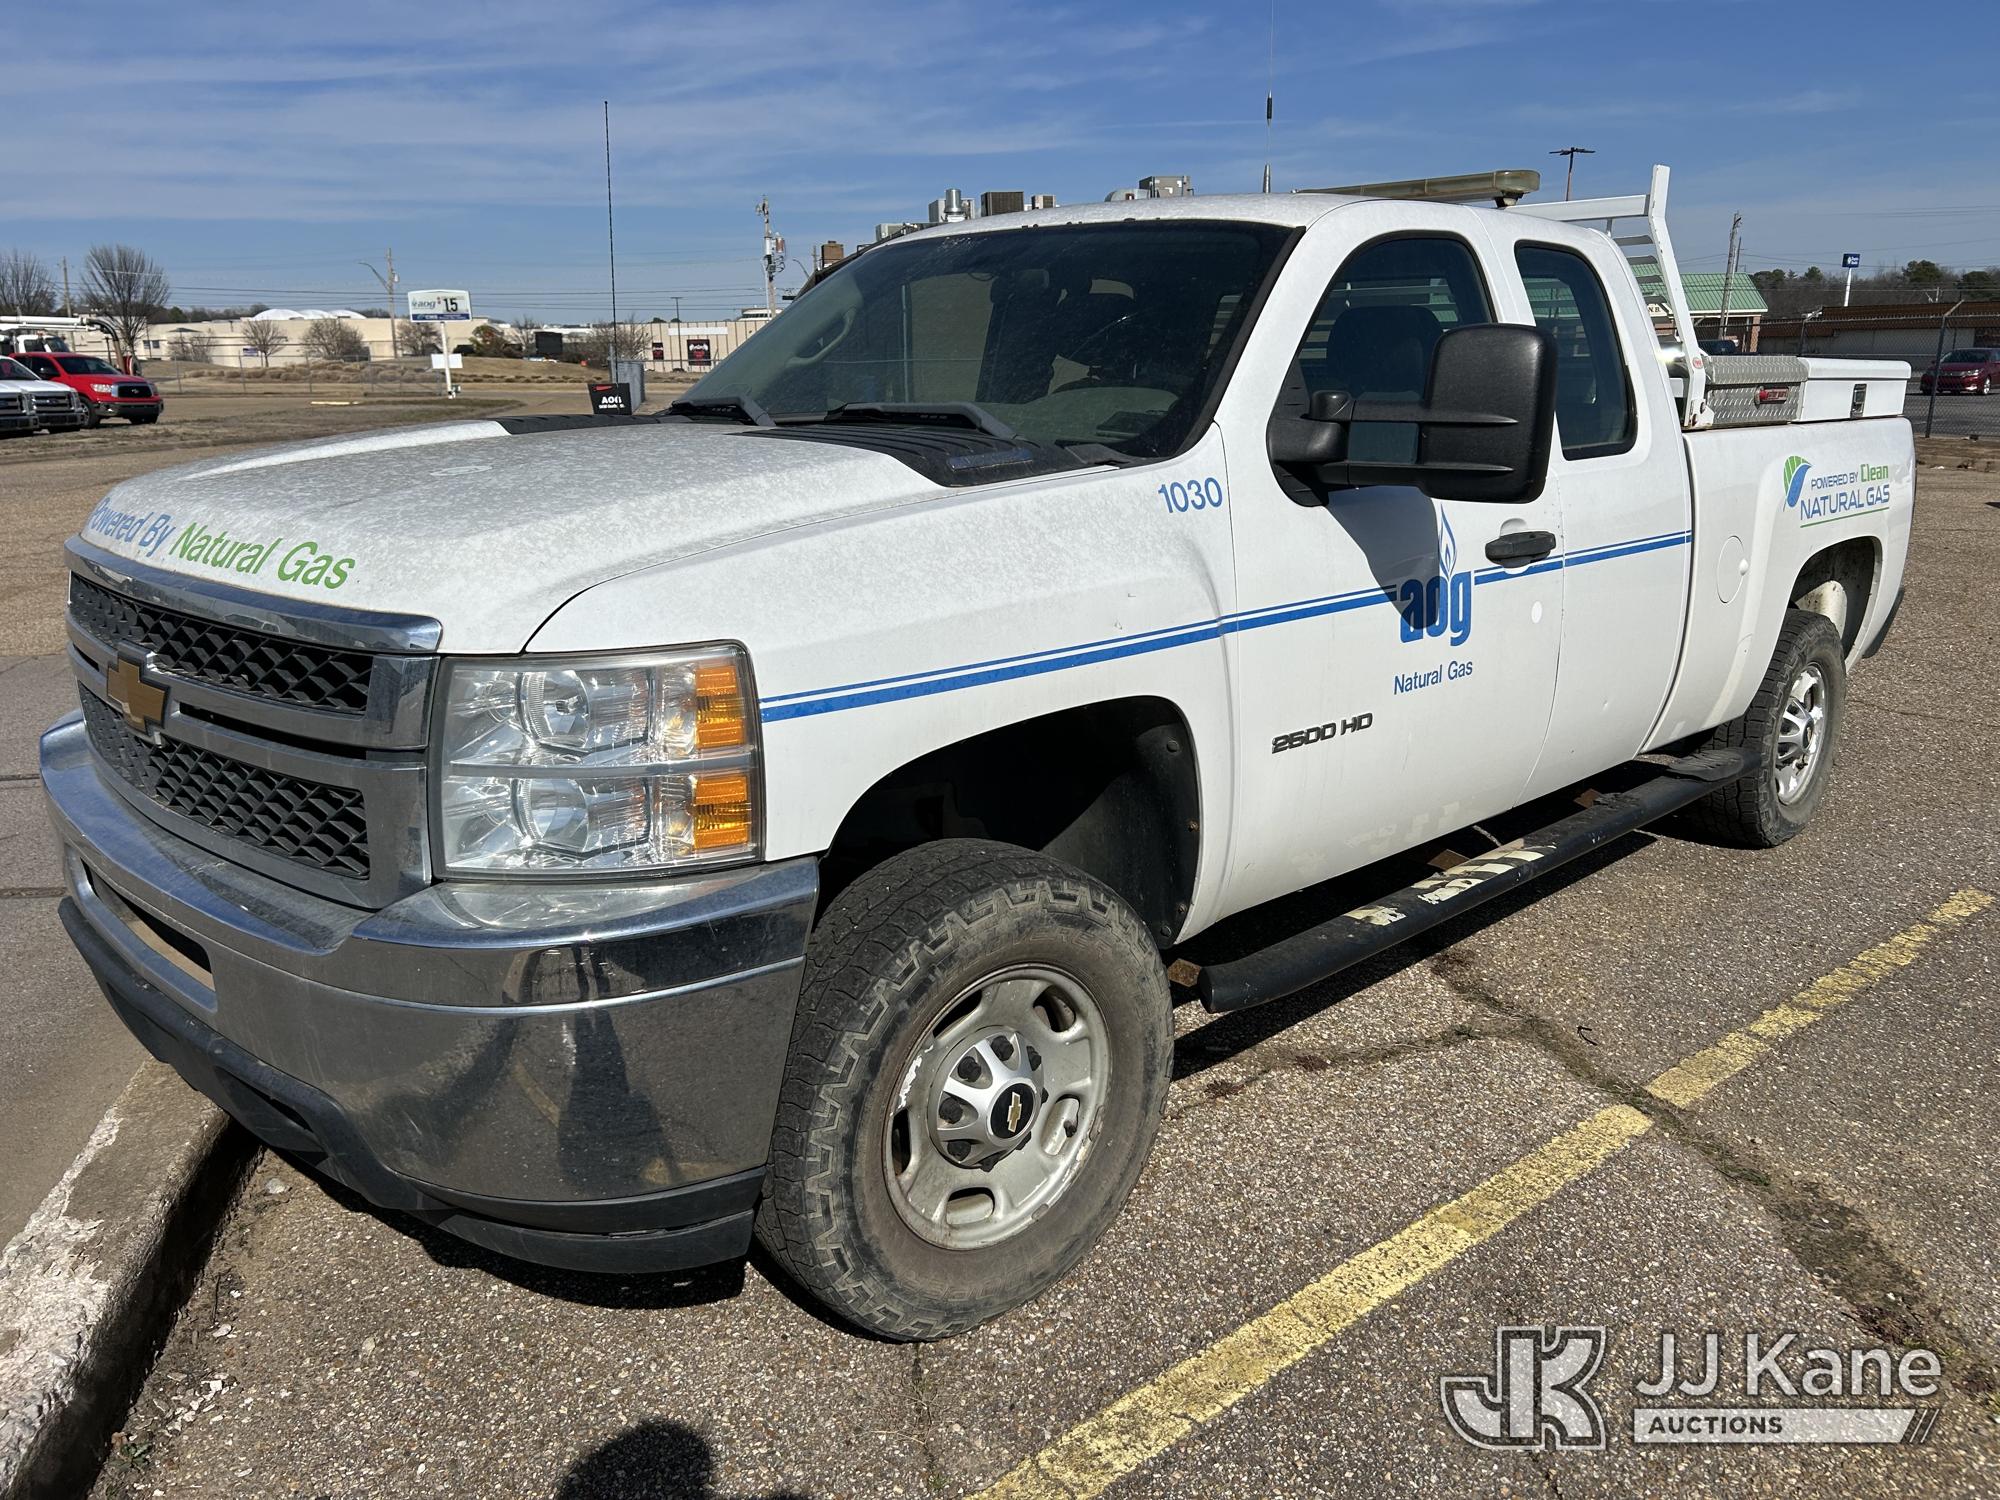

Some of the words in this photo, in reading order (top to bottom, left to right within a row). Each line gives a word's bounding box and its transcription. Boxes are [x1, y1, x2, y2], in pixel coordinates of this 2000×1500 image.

[1811, 473, 1848, 489] POWERED
[1849, 471, 1859, 483] BY
[1860, 463, 1889, 483] Clean
[1158, 477, 1223, 513] 1030
[1800, 489, 1865, 520] NATURAL
[1866, 484, 1890, 506] GAS
[90, 497, 154, 543] Powered
[138, 514, 176, 557] By
[168, 522, 283, 575] Natural
[277, 541, 356, 589] Gas
[1400, 570, 1472, 647] aog
[1393, 664, 1443, 695] Natural
[1447, 660, 1473, 681] Gas
[1340, 712, 1373, 736] HD
